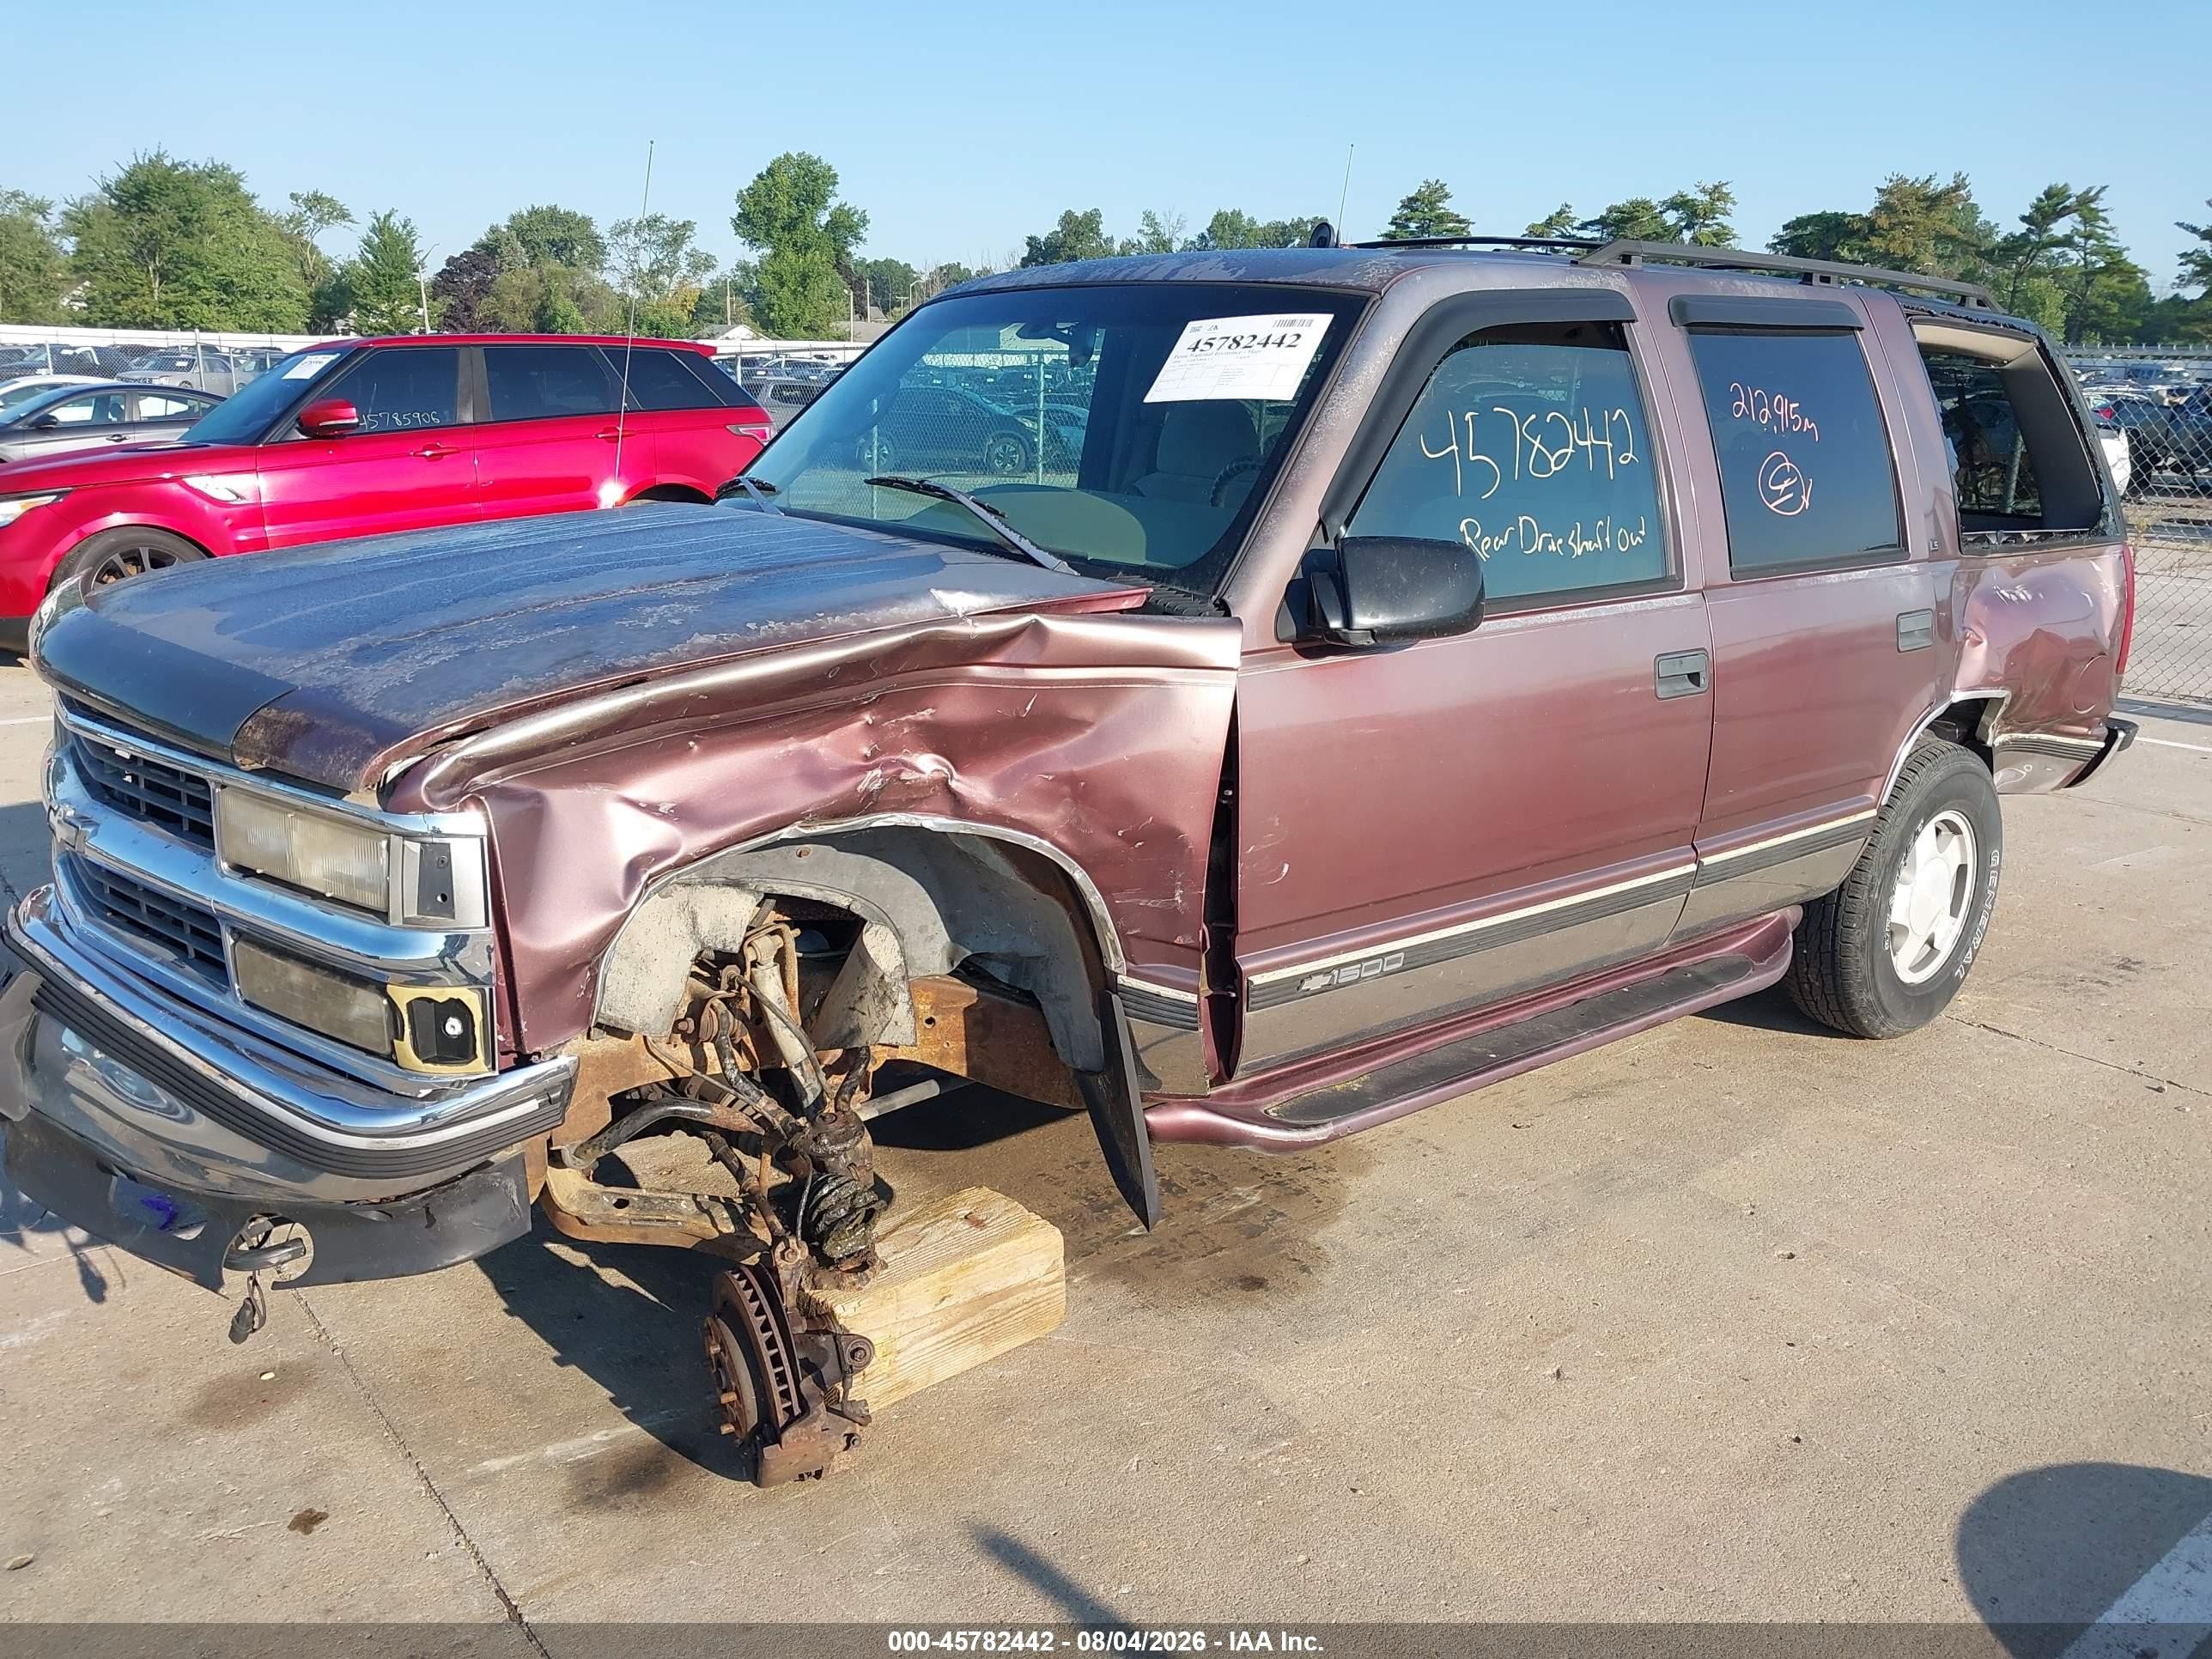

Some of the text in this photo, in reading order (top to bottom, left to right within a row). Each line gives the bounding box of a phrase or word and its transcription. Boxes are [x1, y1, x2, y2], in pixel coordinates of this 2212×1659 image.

[1187, 333, 1302, 352] 45782442
[1420, 406, 1639, 500] 45782442
[1460, 517, 1515, 562] Rear
[1954, 850, 2000, 980] GENERAL
[1332, 951, 1405, 985] 1500
